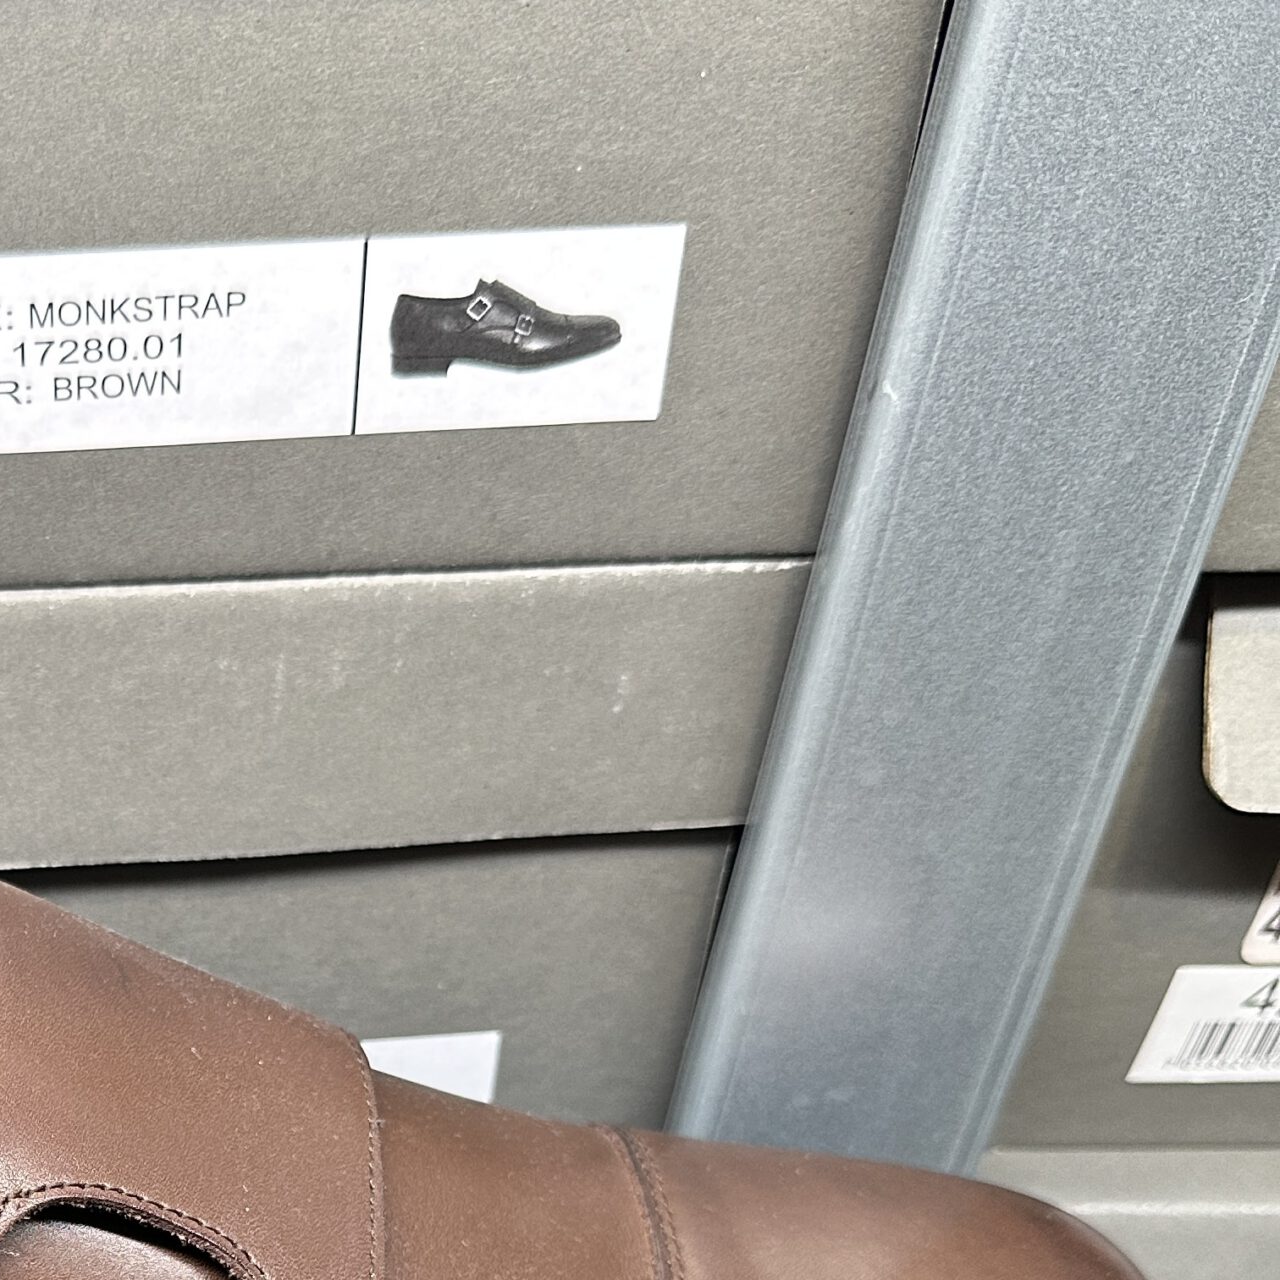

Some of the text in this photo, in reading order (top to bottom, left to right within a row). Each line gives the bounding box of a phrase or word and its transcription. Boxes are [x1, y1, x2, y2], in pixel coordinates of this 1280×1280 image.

[29, 291, 247, 329] MONKSTRAP
[12, 332, 184, 367] 17280.01
[53, 368, 182, 402] BROWN
